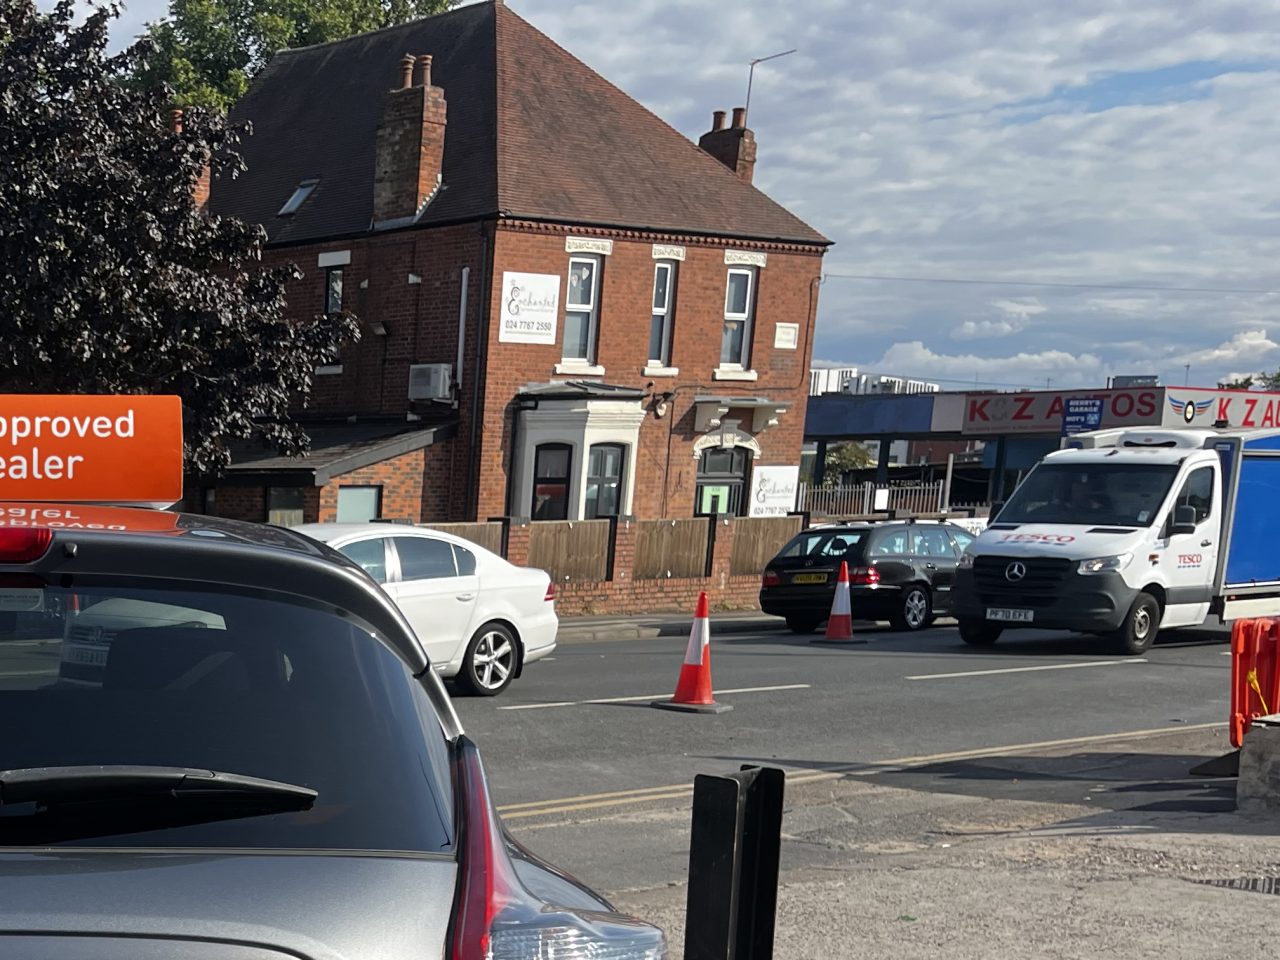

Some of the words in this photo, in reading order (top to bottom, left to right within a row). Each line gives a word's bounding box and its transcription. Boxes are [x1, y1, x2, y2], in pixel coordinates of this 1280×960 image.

[505, 319, 518, 329] 024
[969, 399, 991, 422] K
[1011, 397, 1036, 420] Z
[1045, 392, 1156, 419] AOS
[1218, 397, 1232, 420] K
[1241, 399, 1258, 427] Z
[1003, 533, 1076, 543] TESCO
[1178, 553, 1202, 564] TESCO
